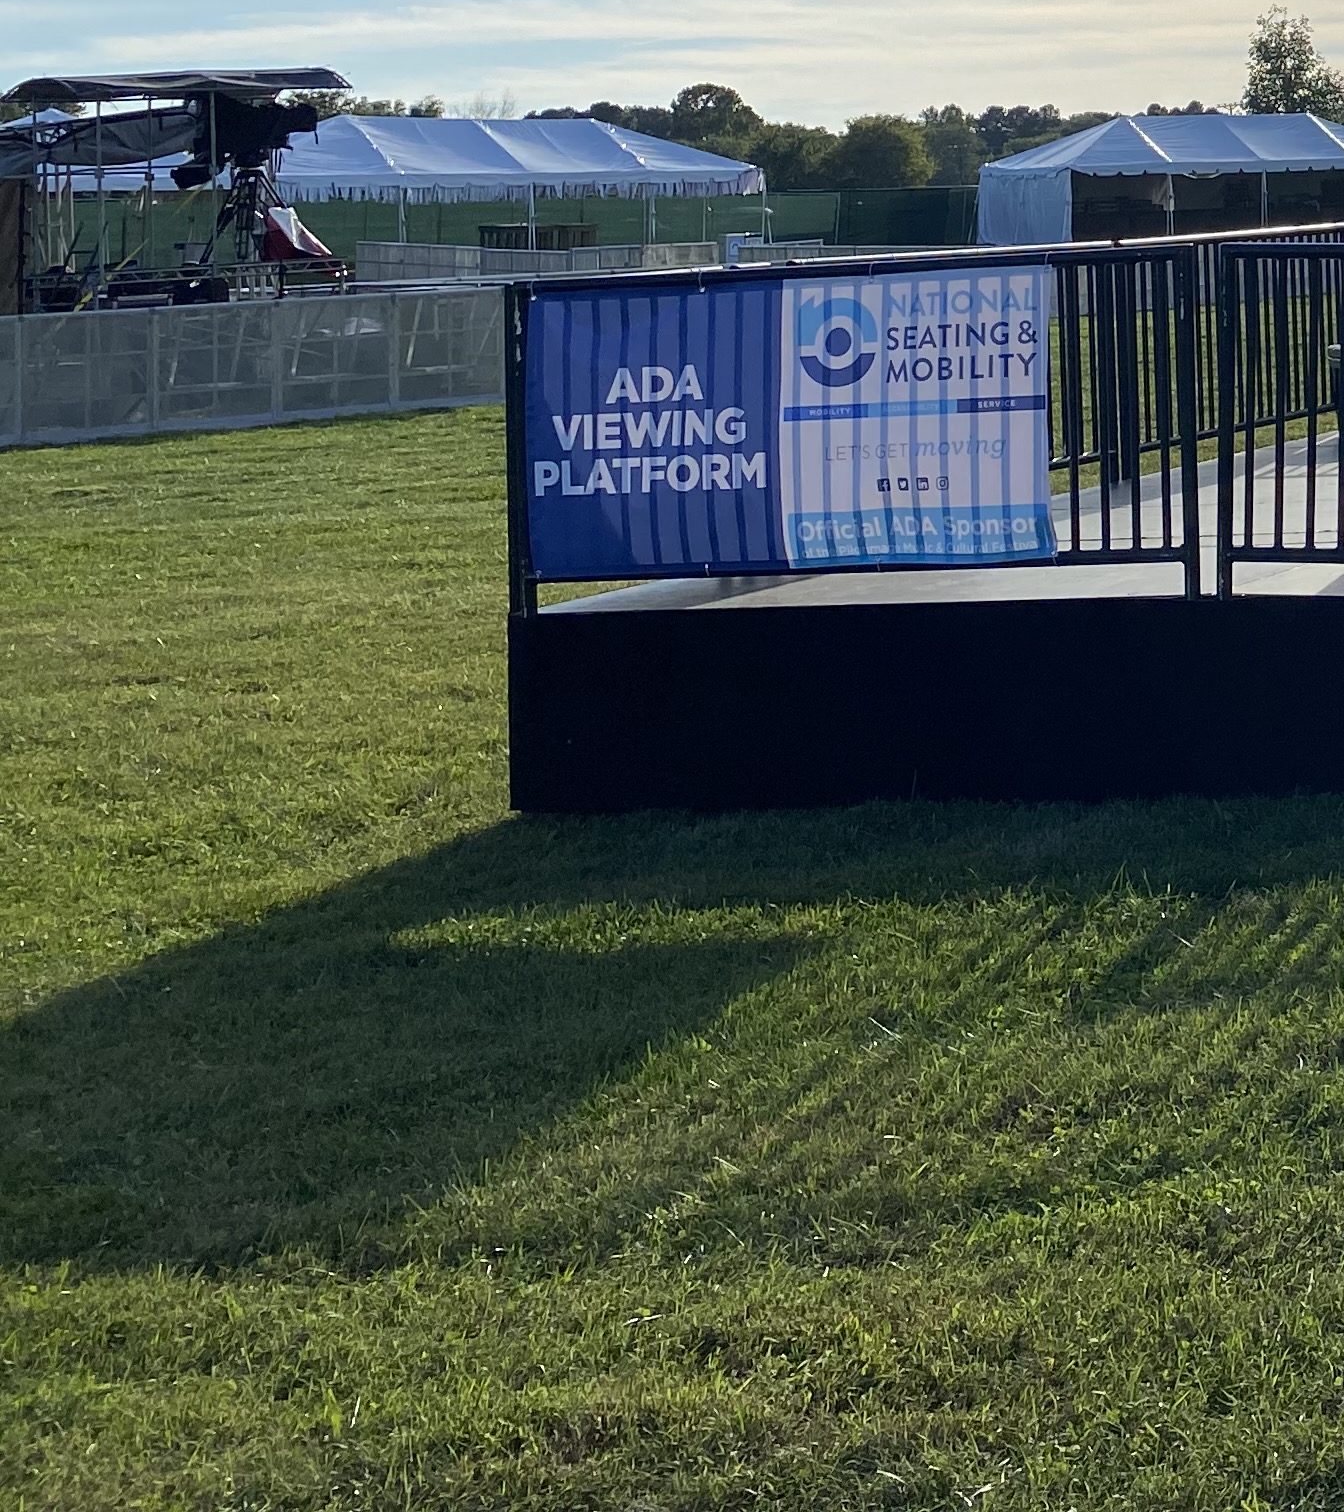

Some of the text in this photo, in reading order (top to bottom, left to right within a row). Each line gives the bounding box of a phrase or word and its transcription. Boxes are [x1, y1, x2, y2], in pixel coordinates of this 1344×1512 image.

[888, 287, 1038, 317] NATIONAL
[886, 320, 1038, 351] SEATING &
[886, 352, 1037, 384] MOBILITY
[605, 364, 704, 405] ADA
[808, 407, 851, 417] MOBILITY
[977, 399, 1016, 409] SERVICE
[552, 407, 747, 451] VIEWING
[825, 434, 1007, 462] LET'S GET moving
[534, 452, 767, 497] PLATFORM
[797, 515, 1037, 542] Official ADA Sponsor
[991, 539, 1040, 552] Festiva
